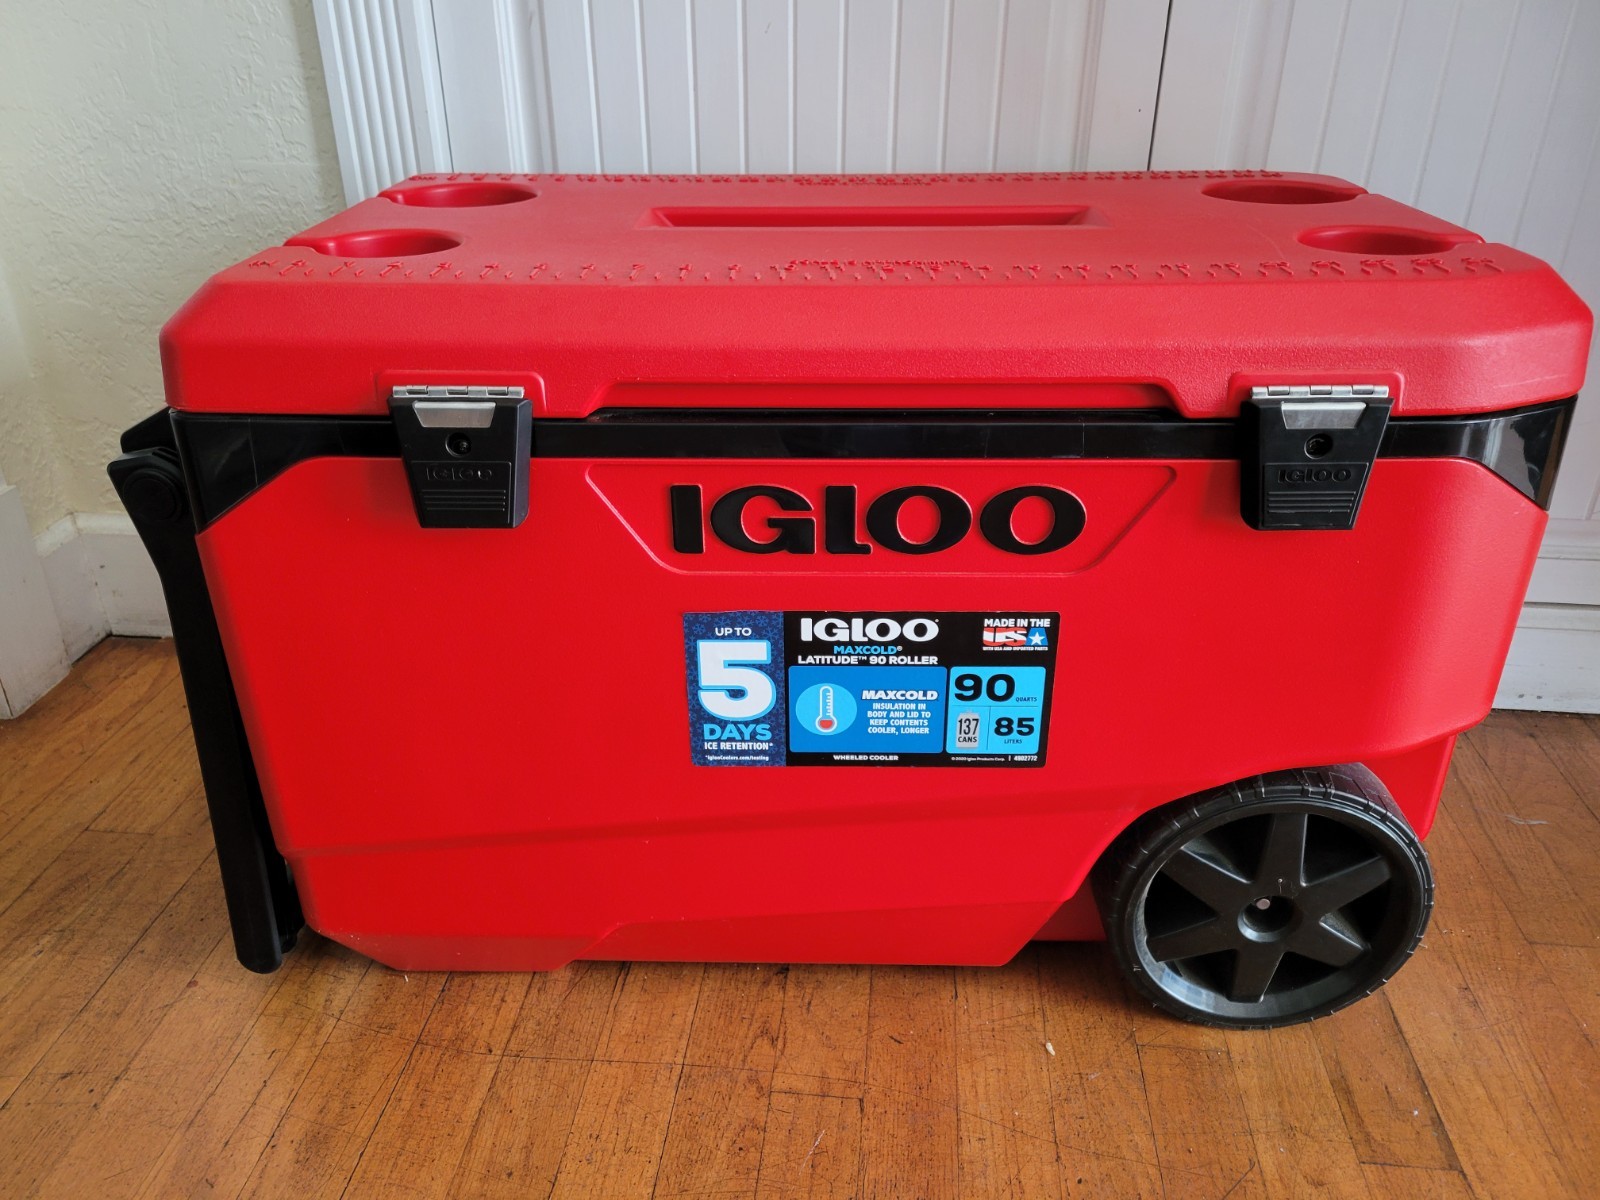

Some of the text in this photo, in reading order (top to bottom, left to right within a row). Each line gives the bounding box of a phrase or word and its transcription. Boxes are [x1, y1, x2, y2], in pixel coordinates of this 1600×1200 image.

[1277, 469, 1352, 483] IGLOO
[669, 483, 1087, 555] IGLOO
[984, 618, 1051, 628] MADE IN THE
[715, 627, 752, 637] UP TO
[869, 655, 887, 665] 90
[888, 655, 938, 665] ROLLER
[697, 640, 777, 721] 5
[954, 673, 1016, 703] 90
[862, 690, 938, 700] MAXCOLD
[921, 711, 931, 719] TO
[890, 719, 929, 727] CONTENTS
[958, 718, 979, 736] 137
[994, 717, 1035, 737] 85
[703, 723, 773, 741] DAYS
[868, 727, 930, 736] COOLER, LONGER
[704, 742, 718, 750] ICE
